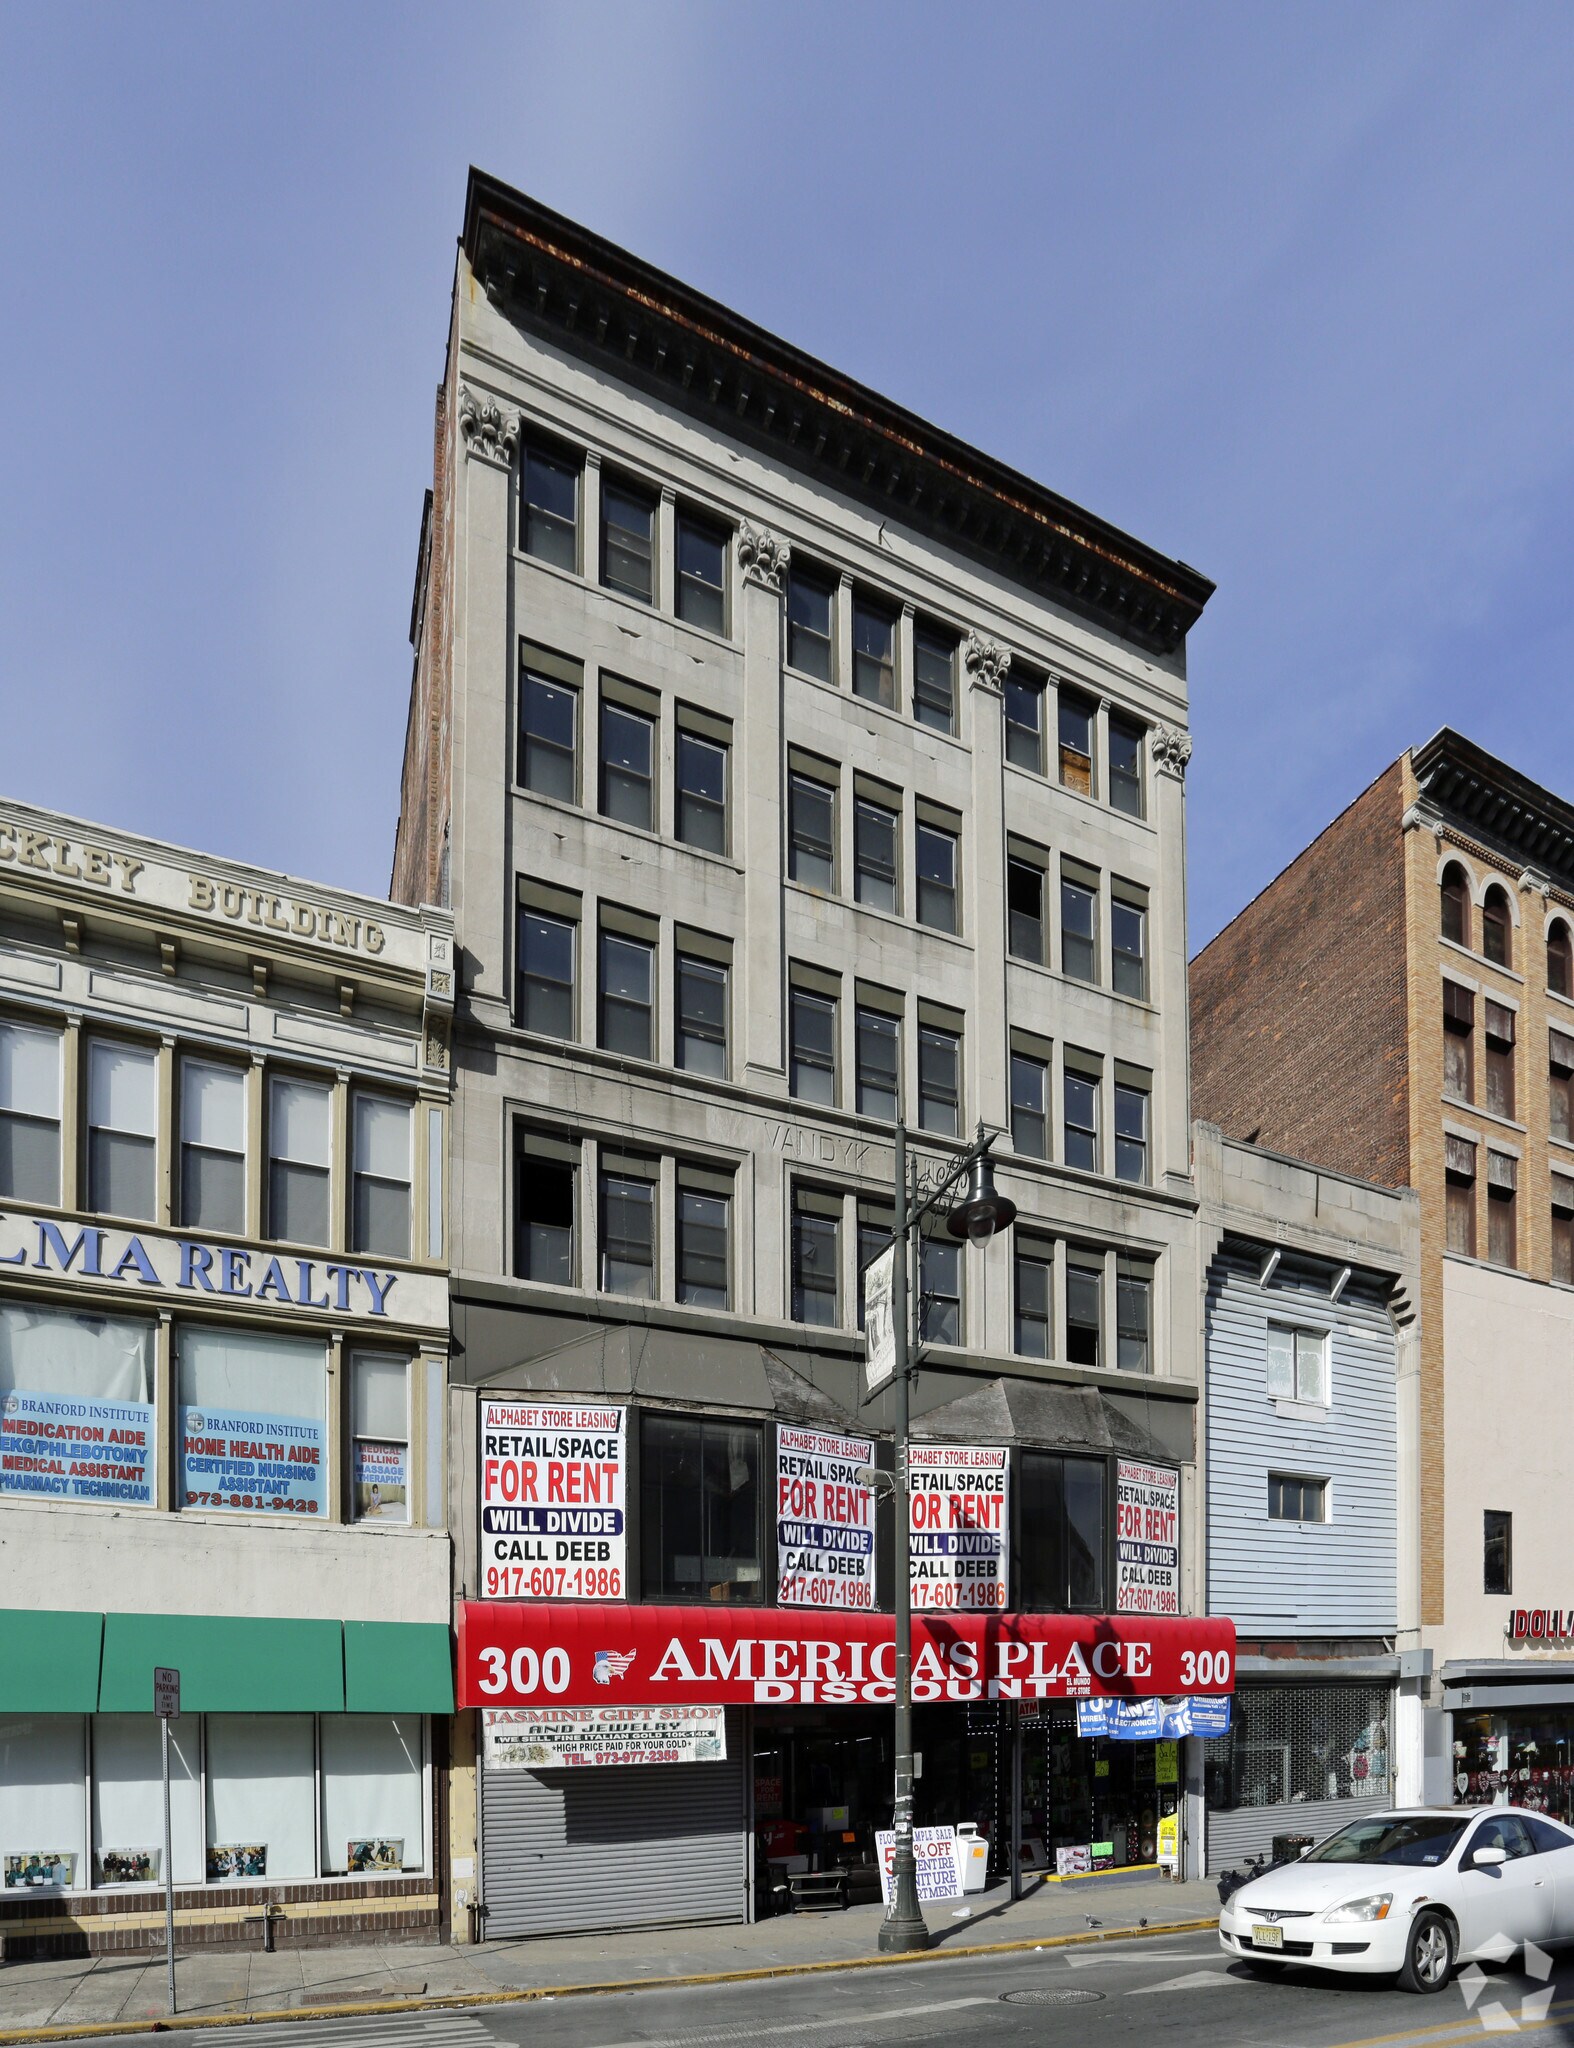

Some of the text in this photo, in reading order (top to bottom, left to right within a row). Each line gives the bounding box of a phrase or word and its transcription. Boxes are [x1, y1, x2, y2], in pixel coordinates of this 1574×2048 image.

[187, 874, 386, 953] BUILDING
[176, 1241, 397, 1316] REALTY
[21, 1400, 149, 1423] BRANFORD INSTITUTE
[488, 1408, 617, 1429] ALPHABET STORE LEASING
[2, 1419, 146, 1446] MEDICATION AIDE
[207, 1418, 319, 1439] BRANFORD INSTITUTE
[0, 1436, 148, 1464] EKG/PHLEBOTOMY
[184, 1436, 320, 1464] HOME HEALTH AIDE
[485, 1435, 618, 1459] RETAIL/SPACE
[781, 1431, 868, 1460] ALPHABET STORE LEASING
[2, 1455, 145, 1482] MEDICAL ASSISTANT
[187, 1457, 316, 1481] CERTIFIED NURSING
[361, 1454, 400, 1465] BILLING
[909, 1451, 1003, 1466] LPHABET STORE LEASING
[356, 1465, 404, 1475] MASSAGE
[485, 1459, 618, 1503] FOR RENT
[780, 1455, 865, 1486] RETAIL/SPAC
[0, 1473, 150, 1500] PHARMACY TECHNICIAN
[218, 1476, 290, 1495] ASSISTANT
[911, 1473, 1004, 1491] ETAIL/SPACE
[186, 1491, 318, 1513] 973-881-9428
[780, 1477, 870, 1525] FOR RENT
[909, 1493, 1004, 1529] OR RENT
[490, 1510, 615, 1532] WILL DIVIDE
[1117, 1504, 1176, 1543] FOR RENT
[783, 1524, 868, 1551] WILL DIVIDE
[910, 1535, 1001, 1554] WILL DIVIDE
[494, 1540, 610, 1561] CALL DEEB
[1120, 1543, 1174, 1565] WILL DIVIDE
[786, 1552, 865, 1576] CALL DEEB
[909, 1561, 997, 1578] CALL DEEB
[487, 1566, 621, 1596] 917-607-1986
[1122, 1566, 1172, 1586] CALL DEEB
[780, 1576, 872, 1607] 917-607-1986
[911, 1582, 1005, 1607] 17-607-1986
[1513, 1609, 1574, 1638] DOLL
[162, 1672, 172, 1682] NO
[478, 1638, 1230, 1694] 300 AMERICA'S PLACE 300
[156, 1682, 178, 1694] PARKING
[753, 1678, 1057, 1702] DISCOUNT
[485, 1707, 721, 1727] JASMINE GIFT SHOP
[1020, 1702, 1038, 1715] ATM
[529, 1722, 680, 1734] AND JEWELRY
[554, 1734, 580, 1742] FINE
[584, 1733, 629, 1741] ITALIAN
[632, 1731, 662, 1740] GOLD
[580, 1742, 603, 1752] PRICE
[605, 1741, 623, 1751] PAID
[626, 1741, 641, 1750] FOR
[643, 1740, 664, 1749] YOUR
[562, 1753, 592, 1765] TEL.
[879, 1828, 952, 1844] FLOO MPLE SALE
[927, 1842, 951, 1857] OFF
[917, 1857, 954, 1871] ENTIRE
